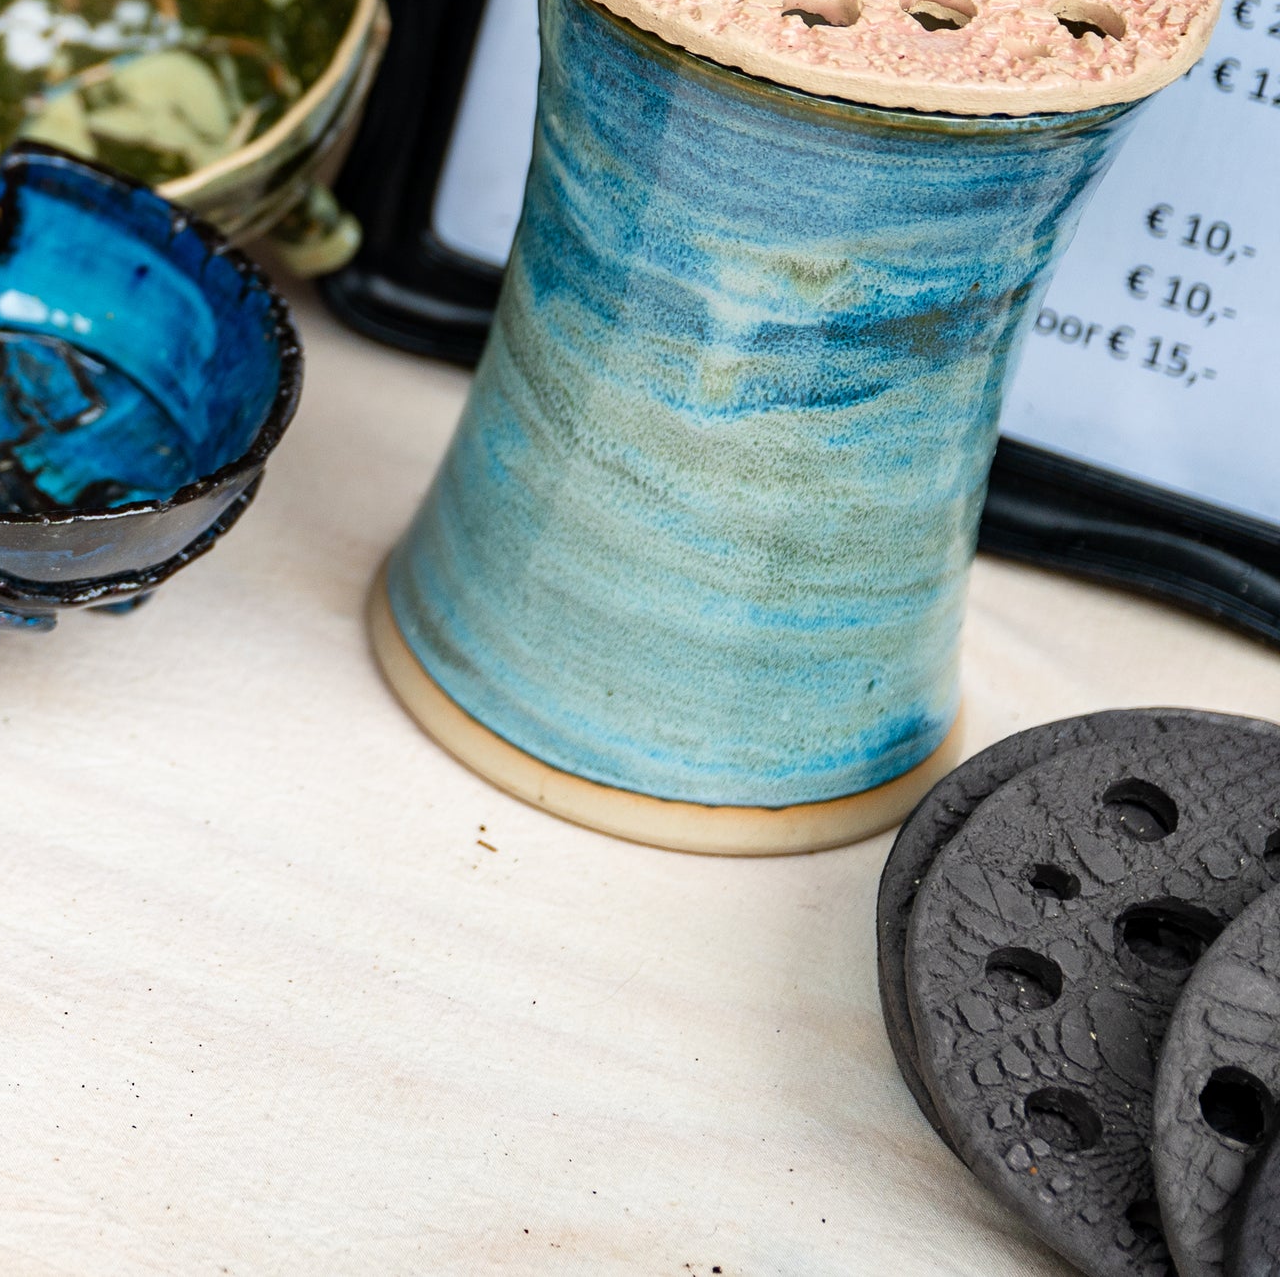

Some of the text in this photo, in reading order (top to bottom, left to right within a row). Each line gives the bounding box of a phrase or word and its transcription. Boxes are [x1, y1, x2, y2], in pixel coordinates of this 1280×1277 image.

[1213, 57, 1241, 93] €
[1146, 202, 1174, 239] €
[1127, 264, 1155, 300] €
[1107, 324, 1136, 361] €
